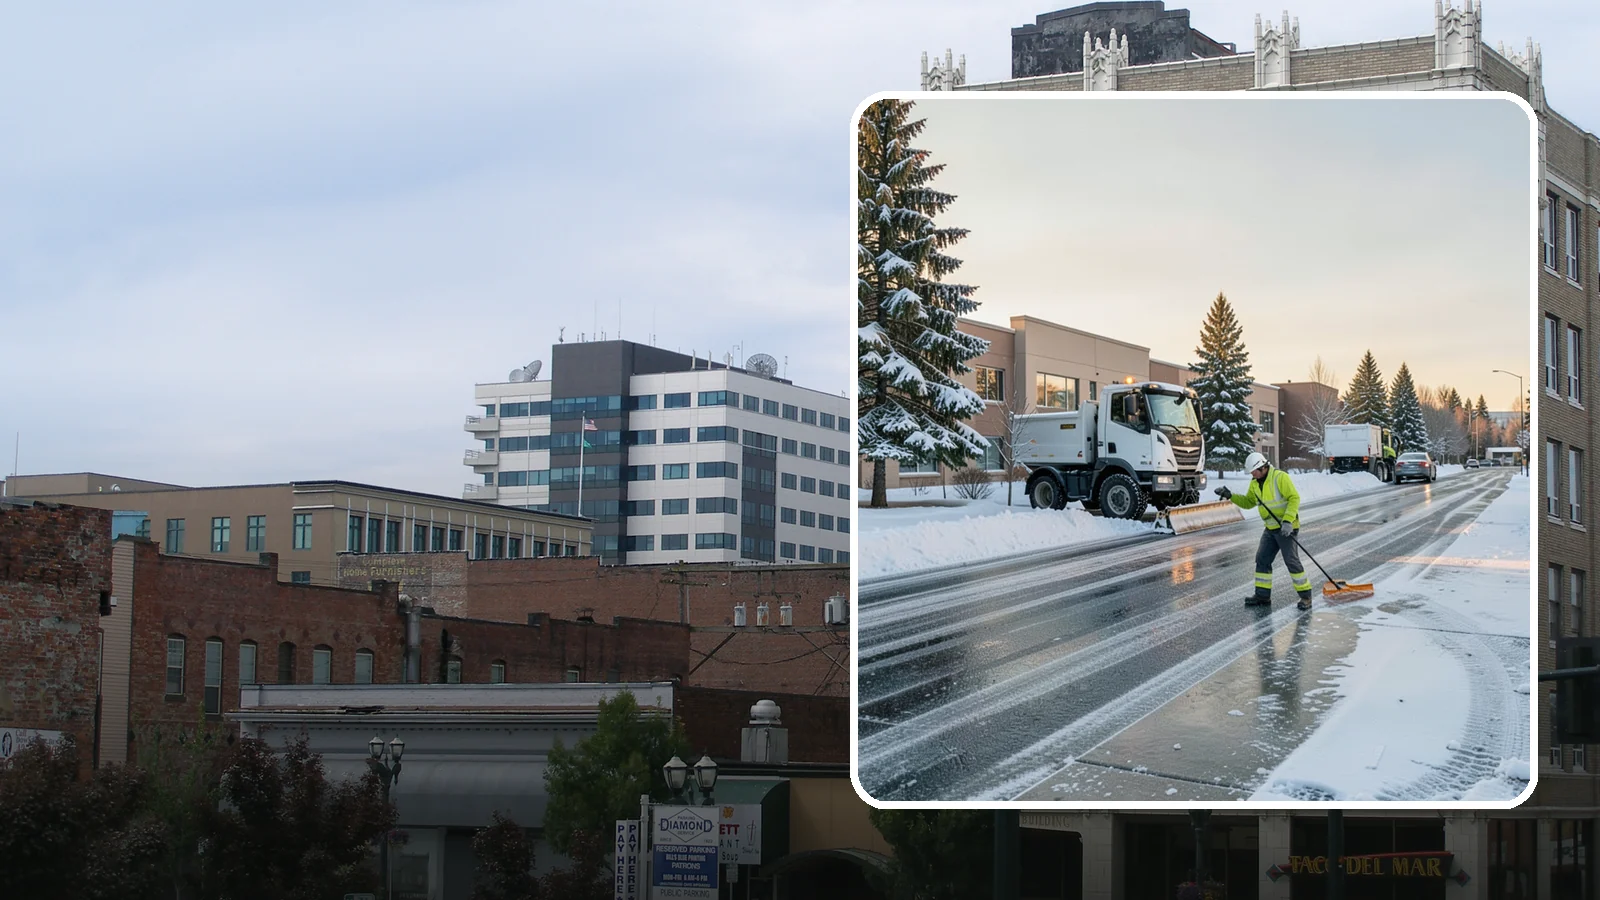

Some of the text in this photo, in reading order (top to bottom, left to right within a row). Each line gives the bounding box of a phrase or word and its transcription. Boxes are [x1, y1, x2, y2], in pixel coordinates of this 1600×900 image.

[370, 566, 427, 577] Furnishers
[660, 818, 713, 832] DIAMOND
[1022, 815, 1070, 828] BUILDING
[617, 825, 625, 852] PAY
[628, 825, 636, 852] PAY
[656, 845, 716, 854] RESERVED PARKING
[721, 852, 739, 861] Soup
[671, 862, 701, 870] PATRONS
[1346, 856, 1384, 876] DEL
[1392, 856, 1442, 877] MAR
[617, 856, 625, 893] HERE
[628, 856, 636, 893] HERE
[660, 889, 710, 898] PUBLIC PARKING
